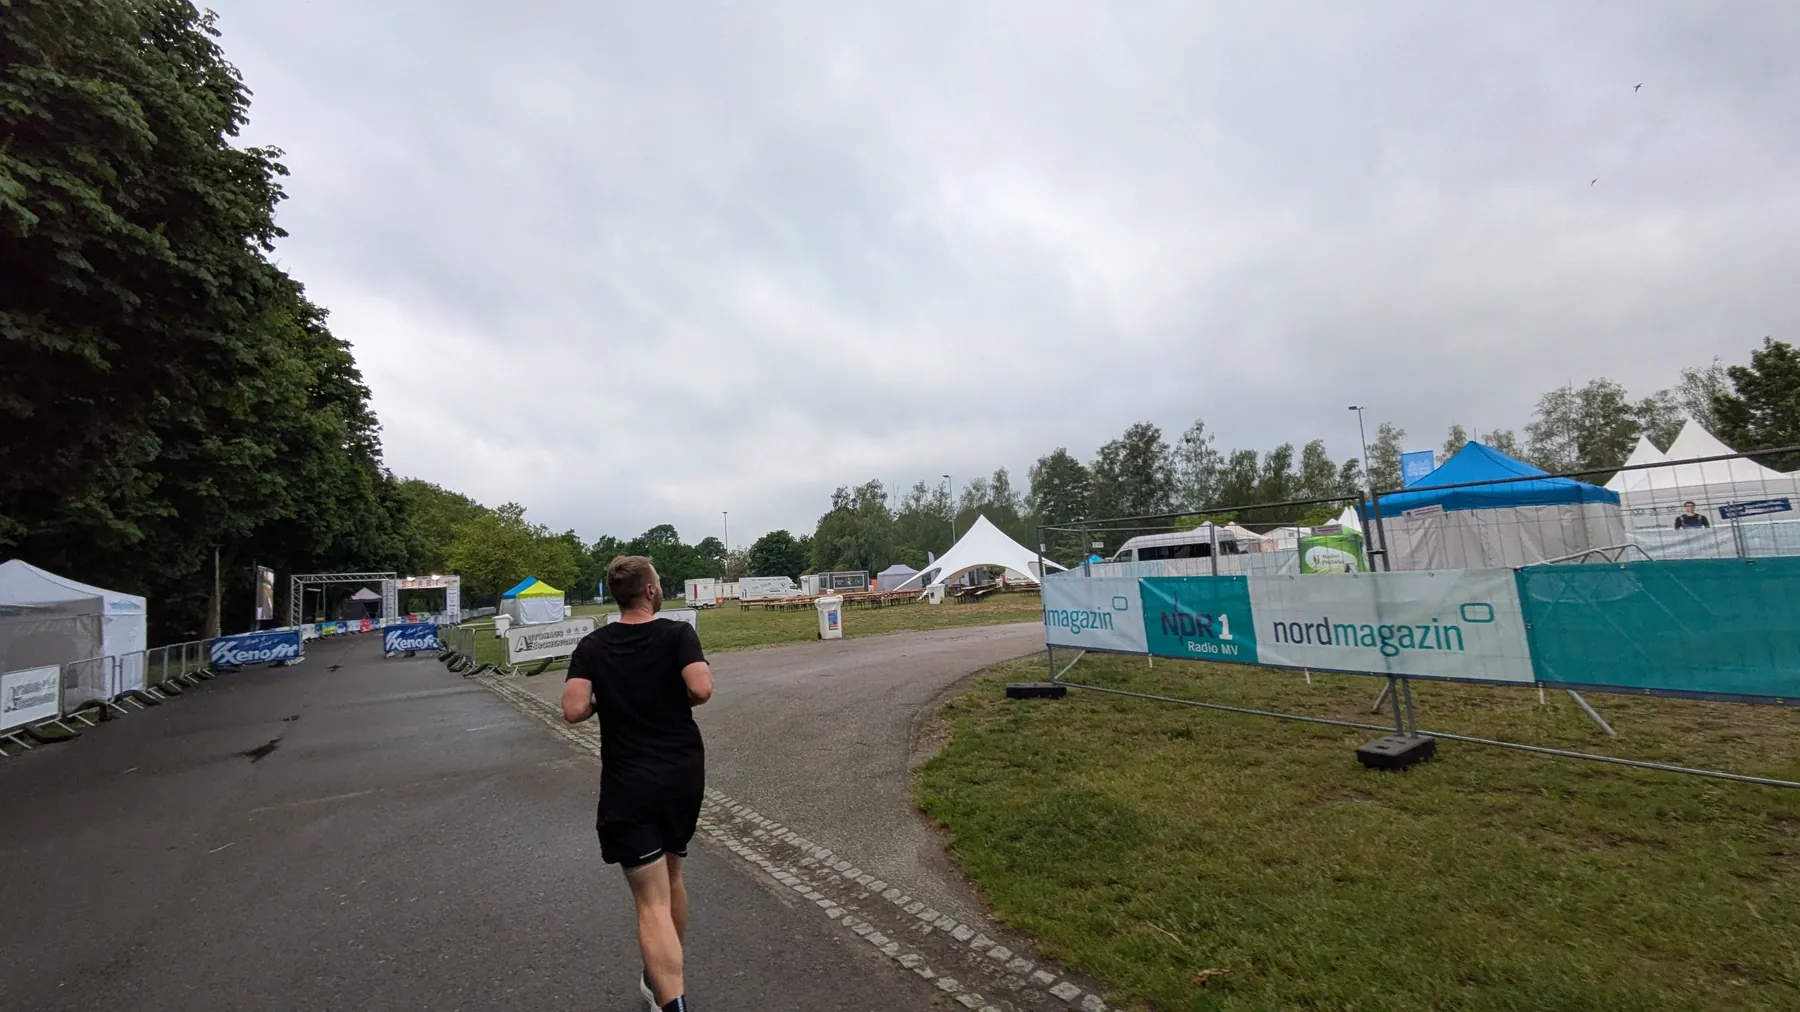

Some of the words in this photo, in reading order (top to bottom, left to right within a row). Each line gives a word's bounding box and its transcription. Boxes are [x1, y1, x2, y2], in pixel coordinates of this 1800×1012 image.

[401, 579, 439, 588] START
[1161, 610, 1216, 639] NDR
[1218, 613, 1233, 641] 1
[1273, 616, 1465, 658] nordmagazin
[1187, 641, 1218, 654] Radio
[1221, 643, 1239, 656] MV
